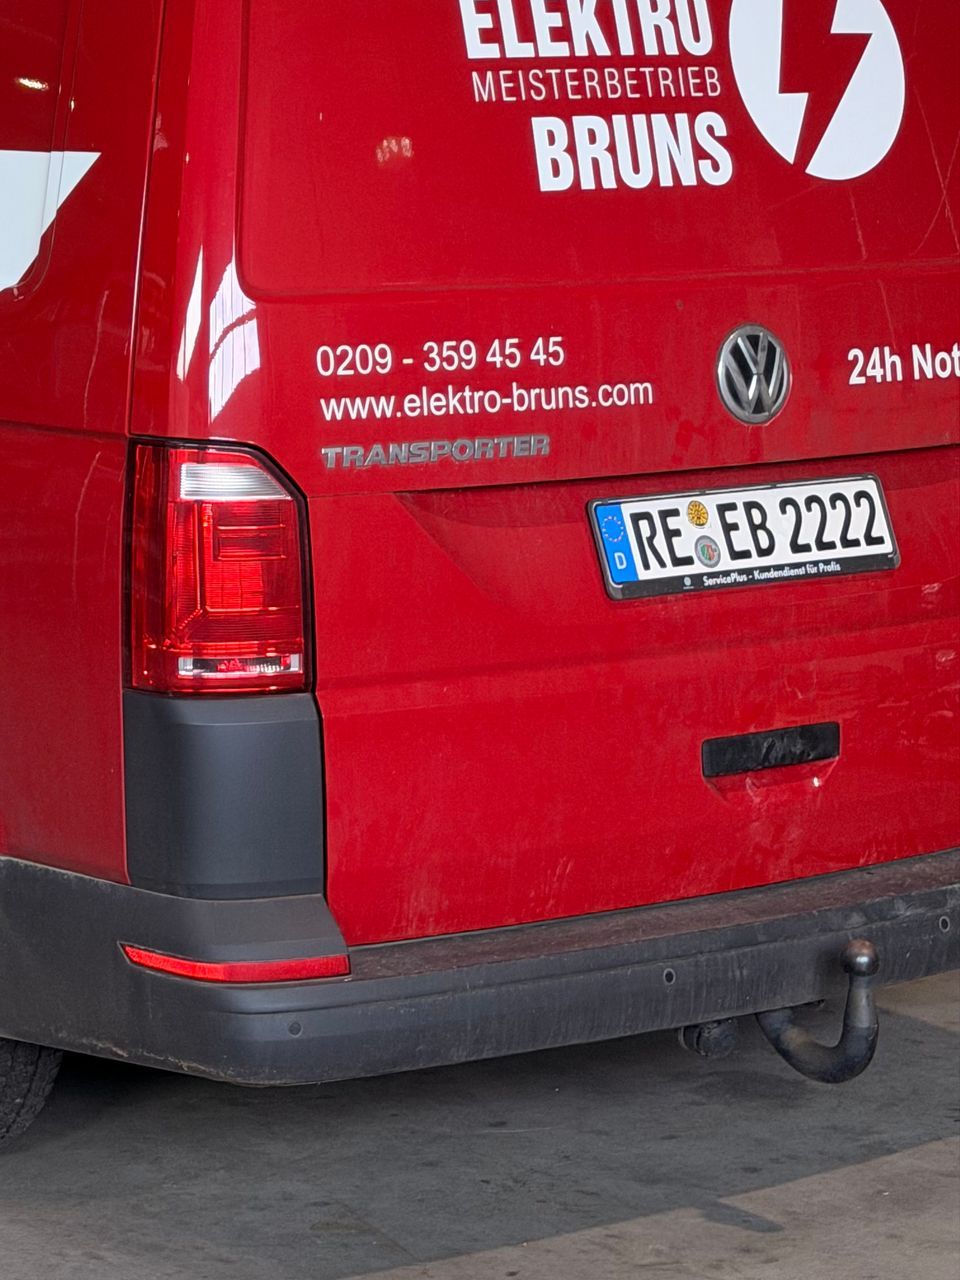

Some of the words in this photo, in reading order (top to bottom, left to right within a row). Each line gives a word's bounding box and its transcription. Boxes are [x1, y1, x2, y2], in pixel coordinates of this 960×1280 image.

[472, 67, 721, 102] MEISTERBETRIEB
[531, 111, 733, 191] BRUNS
[316, 344, 392, 376] 0209
[423, 340, 477, 372] 359
[486, 338, 521, 368] 45
[530, 336, 565, 366] 45
[847, 346, 903, 385] 24h
[320, 381, 653, 421] www.elektro-bruns.com
[321, 435, 551, 468] TRANSPORTER
[614, 552, 627, 569] D
[629, 507, 695, 571] RE
[716, 500, 775, 561] EB
[779, 490, 886, 554] 2222
[702, 572, 747, 587] ServicePlus
[753, 565, 806, 581] Kundendienst
[806, 563, 818, 574] für
[818, 561, 841, 572] Profis
